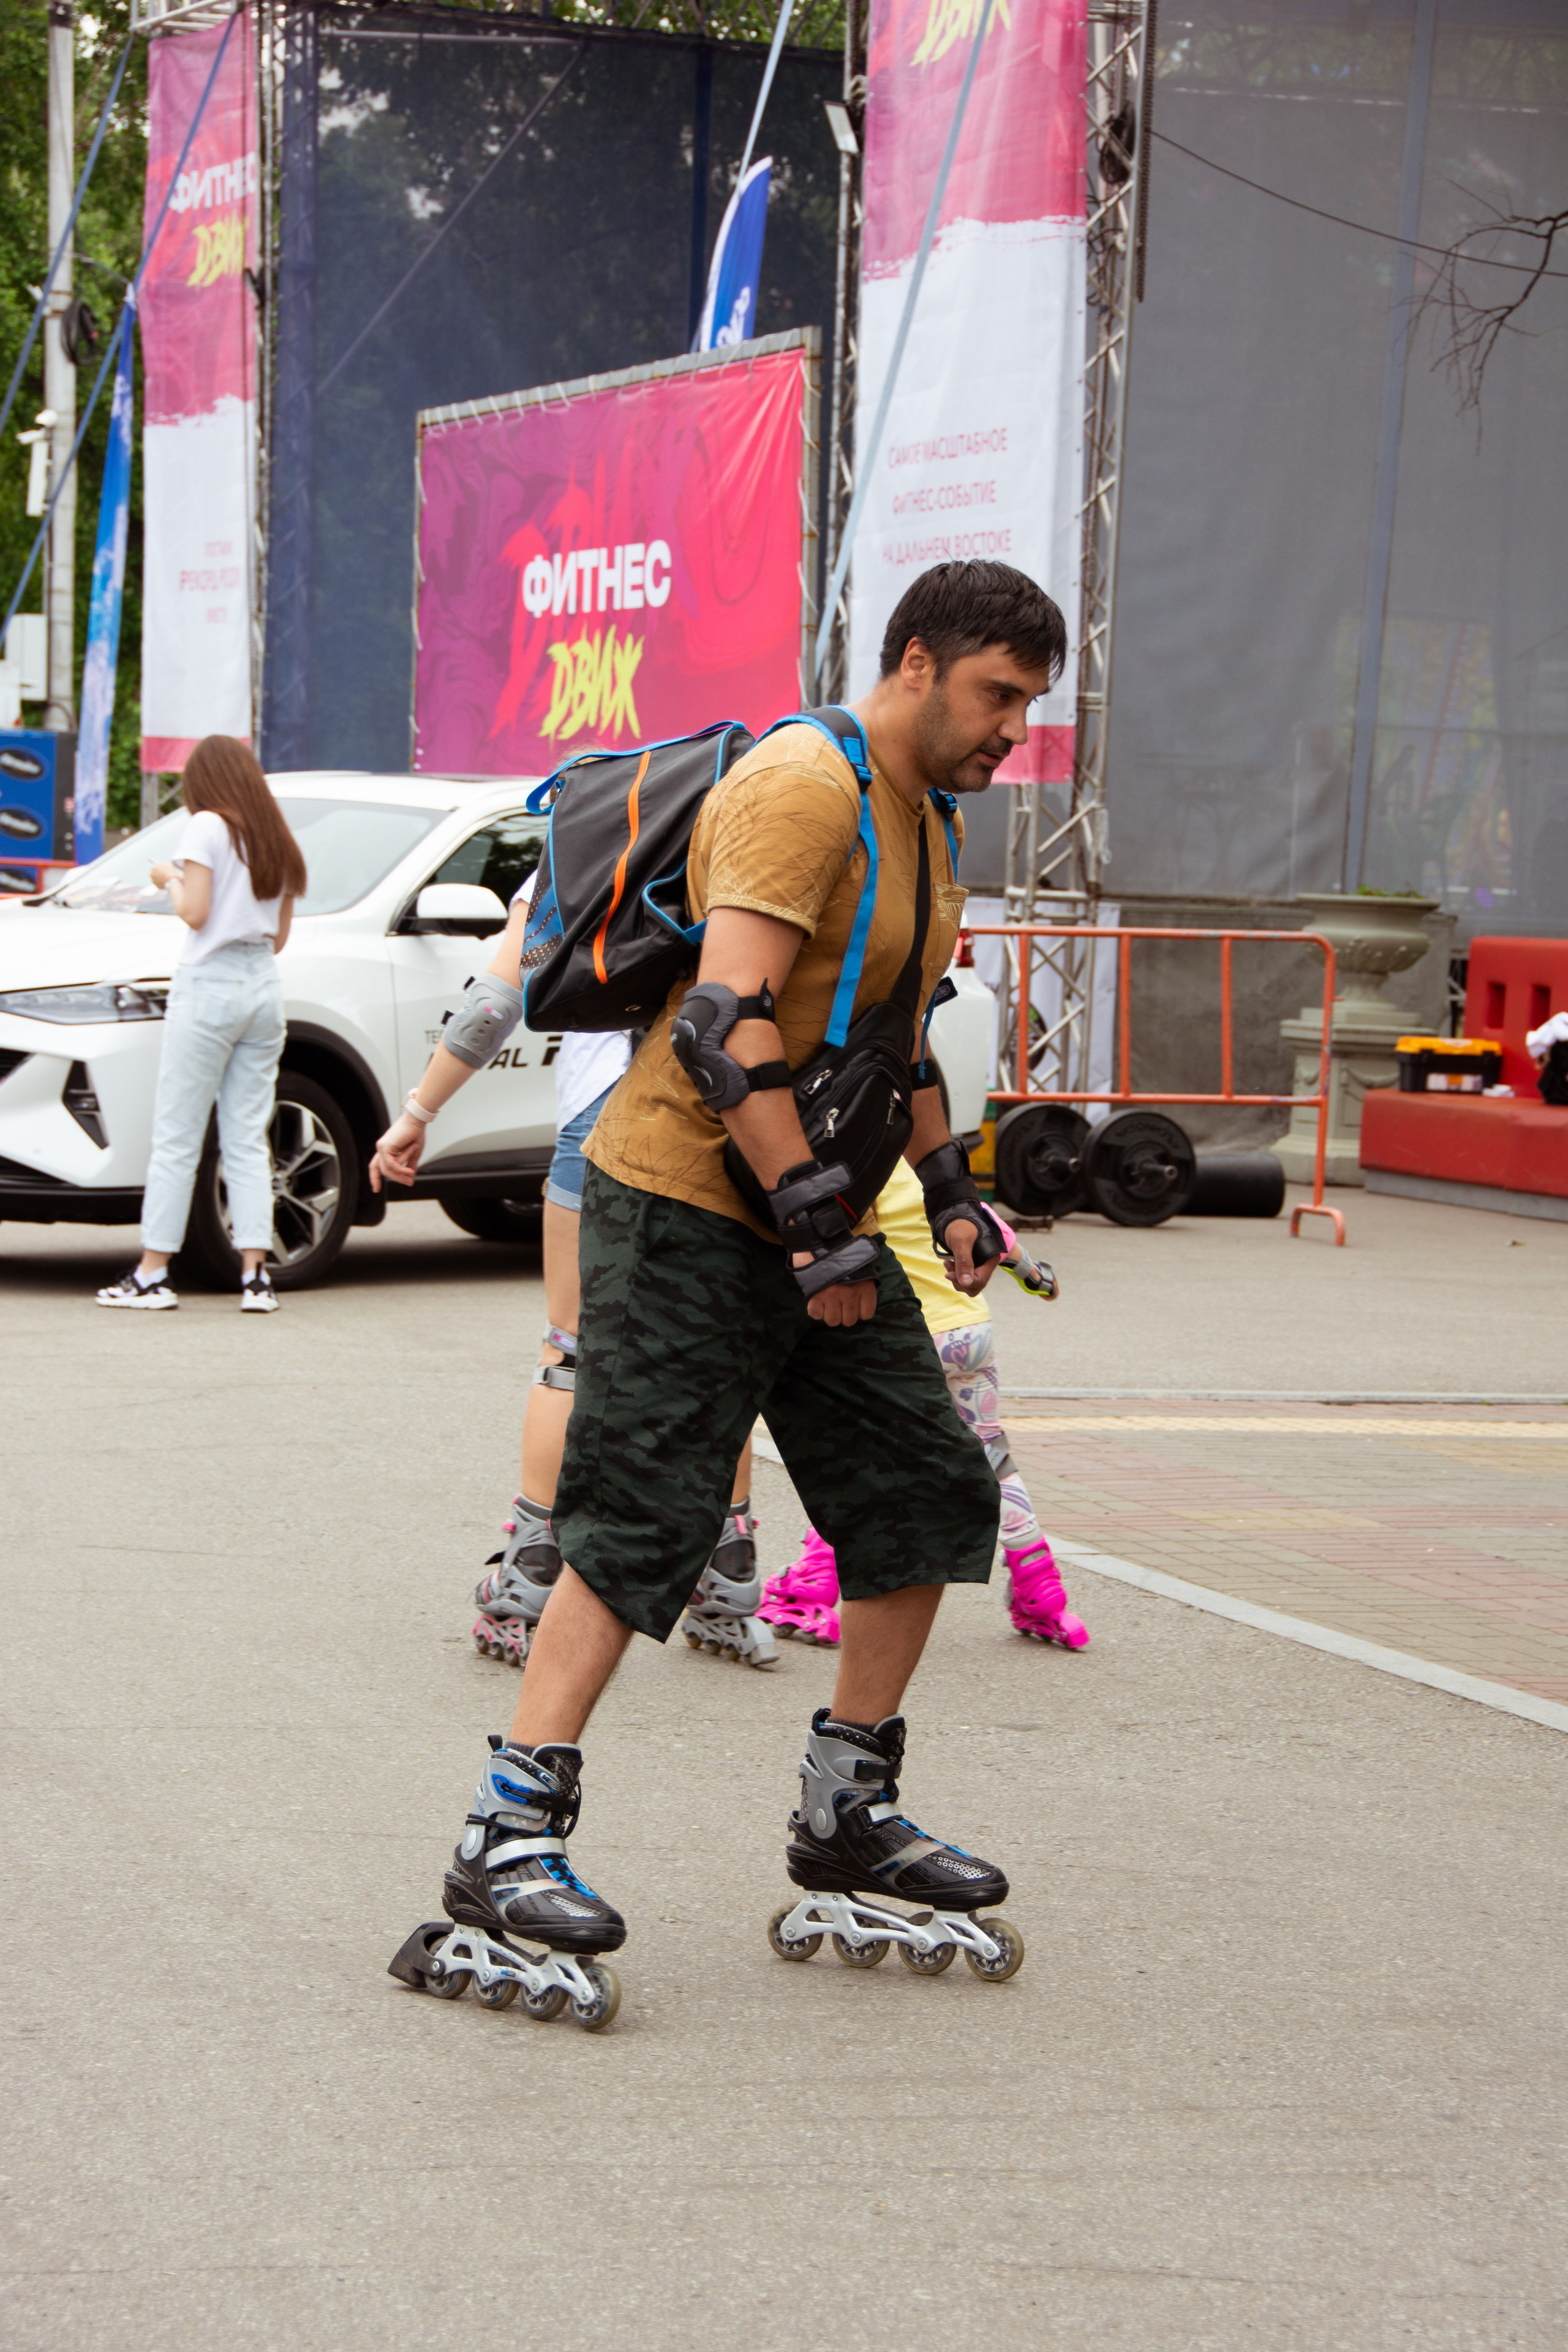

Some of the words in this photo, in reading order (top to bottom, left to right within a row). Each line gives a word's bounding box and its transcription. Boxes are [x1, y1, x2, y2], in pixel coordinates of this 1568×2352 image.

[922, 428, 1008, 462] МАСШТАБНОЕ
[892, 480, 996, 516] ФИТНЕС-СОБЫТИЕ
[896, 535, 951, 567] ДАЛЬНЕМ
[955, 529, 1011, 558] ВОСТОКЕ
[523, 540, 671, 618] ФИТНЕС
